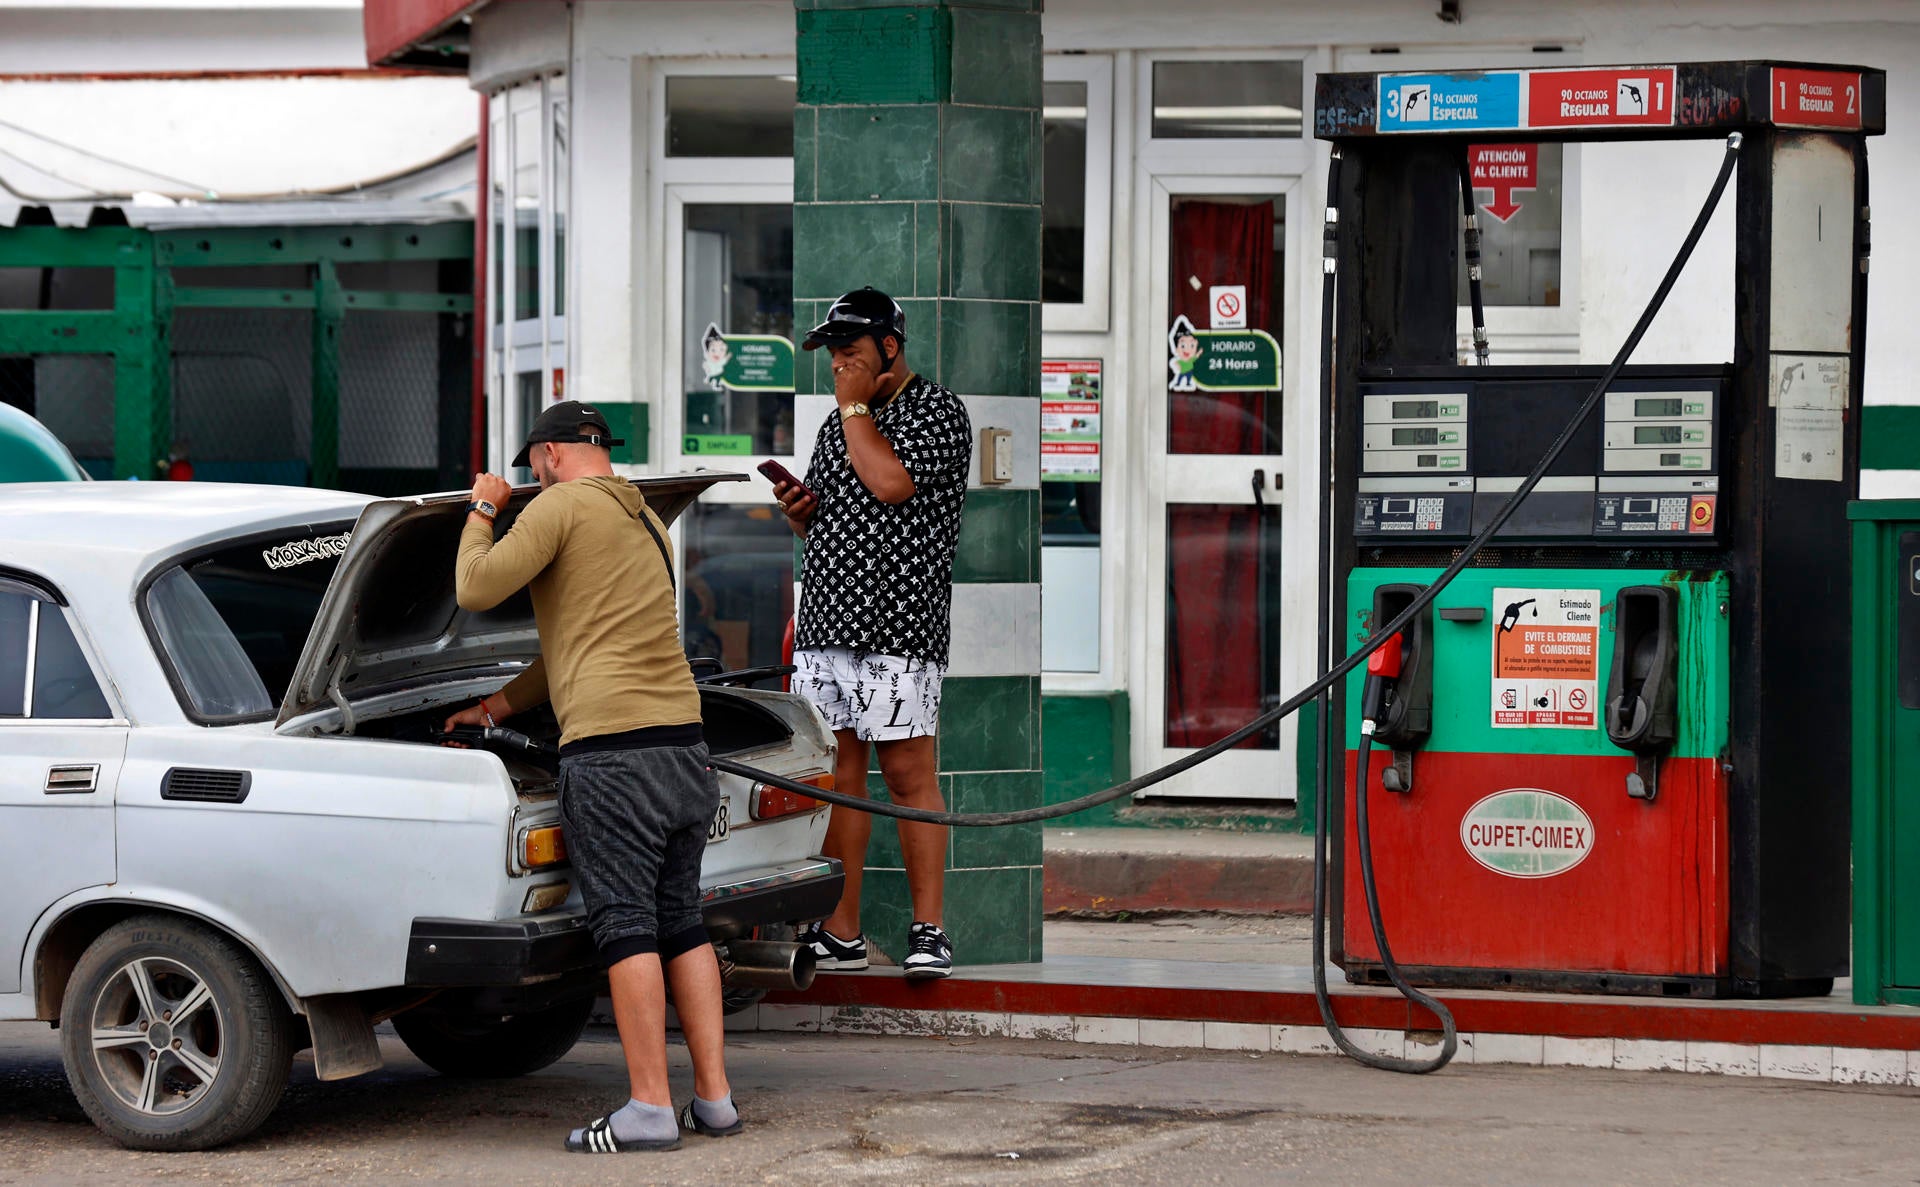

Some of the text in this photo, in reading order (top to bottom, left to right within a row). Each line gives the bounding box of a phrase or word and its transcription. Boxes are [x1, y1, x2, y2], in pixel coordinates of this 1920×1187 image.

[1560, 89, 1608, 100] 90 OCTANOS
[1779, 81, 1786, 110] 1
[1799, 83, 1833, 97] 90 OCTANOS
[1433, 93, 1478, 104] 94 OCTANOS
[1656, 82, 1664, 111] 1
[1845, 85, 1855, 114] 2
[1386, 89, 1399, 118] 3
[1478, 148, 1526, 162] ATENCIÓN
[1474, 165, 1529, 178] AL CLIENTE
[1211, 341, 1256, 352] HORARIO
[1209, 358, 1259, 370] 24 Horas
[1560, 599, 1591, 609] Estimado
[1566, 611, 1591, 621] Cliente
[1525, 631, 1591, 643] EVITE EL DERRAME
[1525, 644, 1591, 655] DE COMBUSTIBLE
[1469, 824, 1585, 849] CUPET-CIMEX
